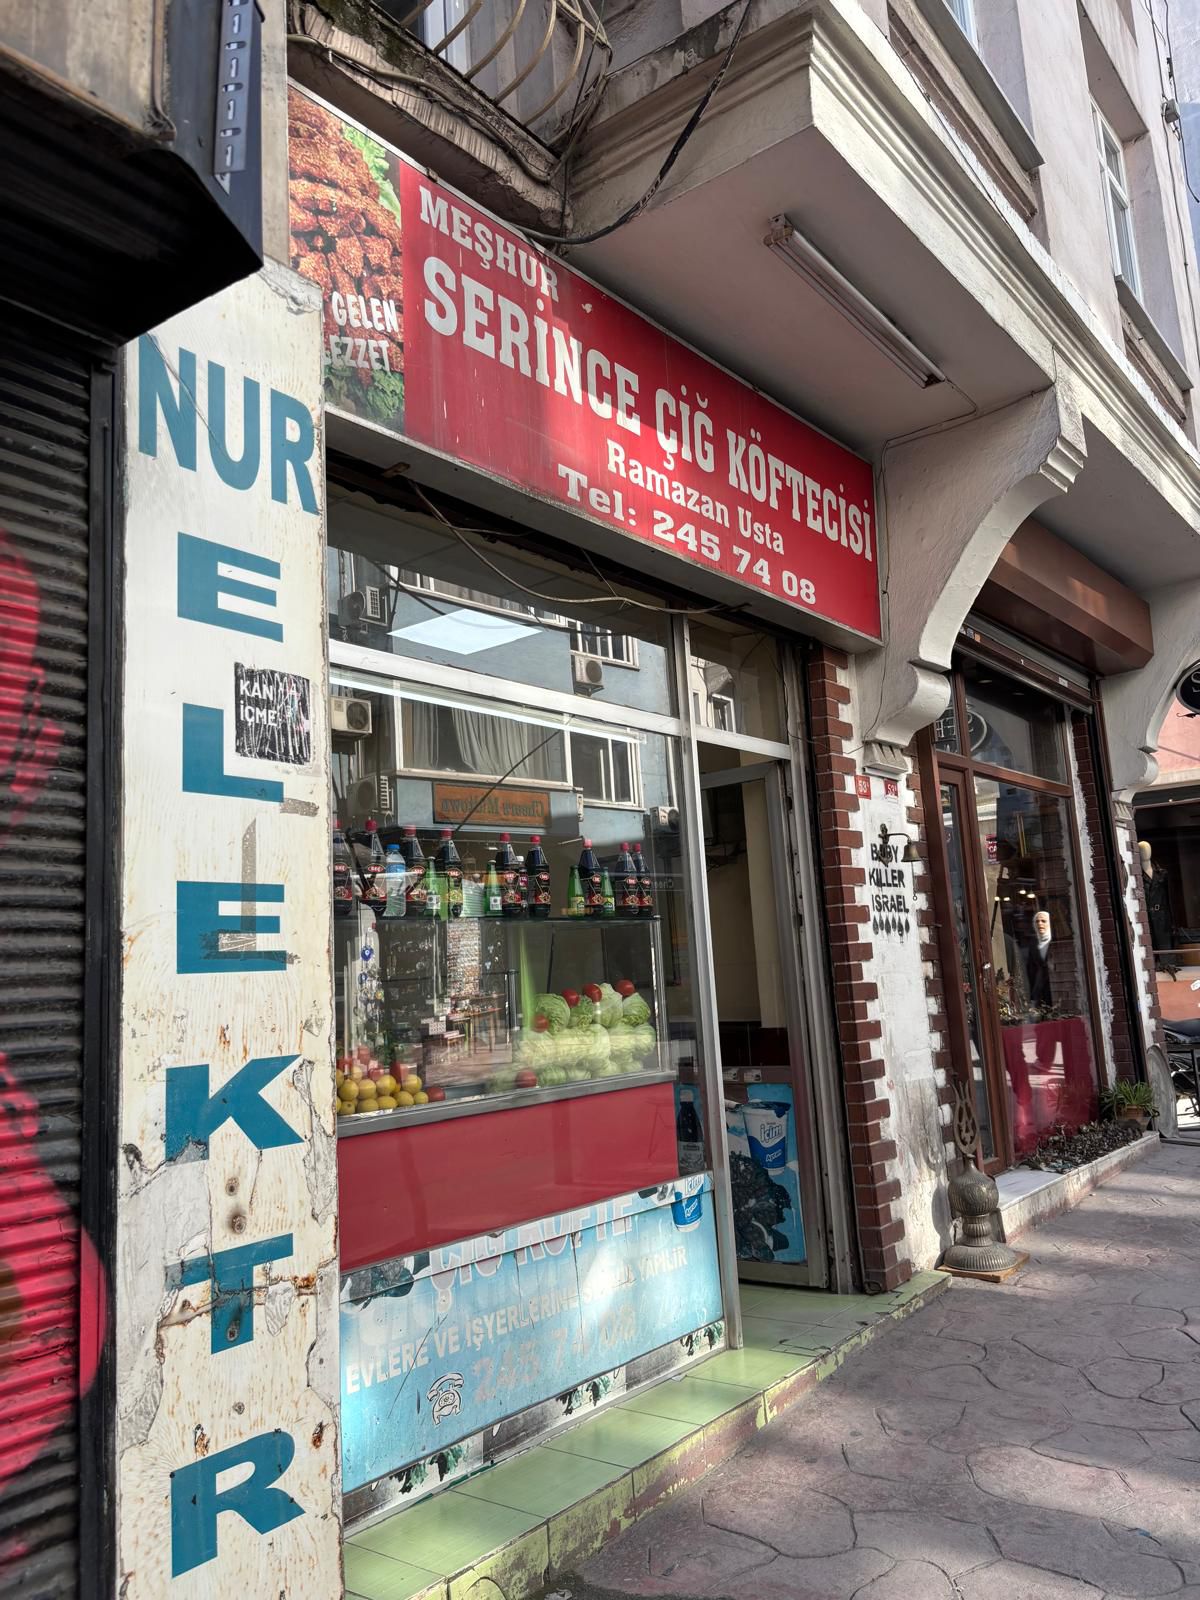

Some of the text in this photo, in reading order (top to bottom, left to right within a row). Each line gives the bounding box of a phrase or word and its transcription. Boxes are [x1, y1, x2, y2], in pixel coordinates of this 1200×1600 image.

[419, 185, 559, 302] MEŞHUR
[332, 291, 399, 333] GELEN
[138, 333, 319, 516] NUR
[423, 256, 872, 562] SERİNCE ÇİĞ KÖFTECİSİ
[558, 464, 816, 605] Tel: 245 74 08
[607, 439, 785, 555] Ramazan Usta
[869, 868, 905, 889] KILLER
[871, 894, 910, 914] ISRAEL
[346, 1340, 430, 1394] EVLERE
[433, 1327, 461, 1358] VE
